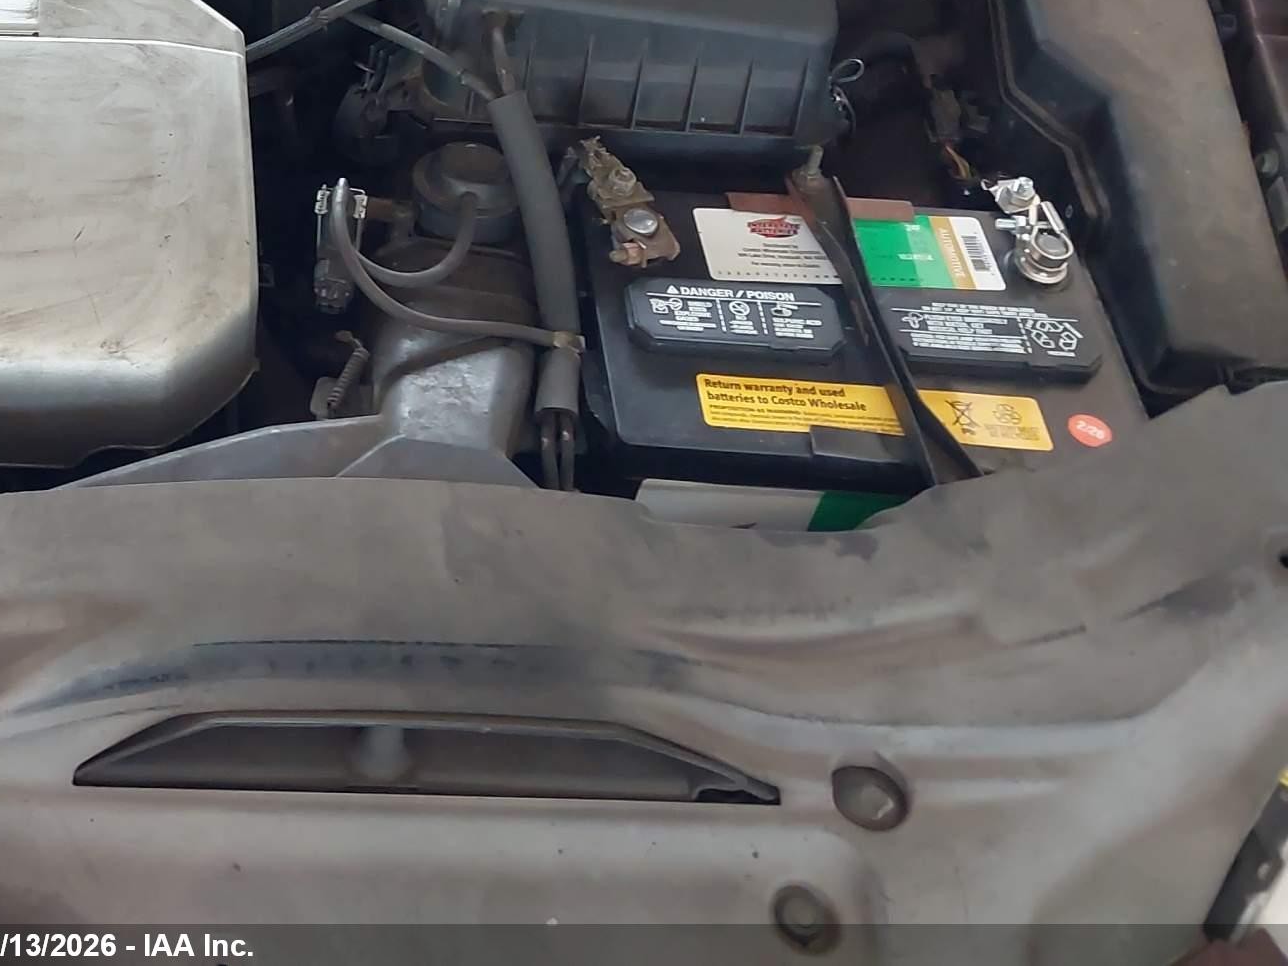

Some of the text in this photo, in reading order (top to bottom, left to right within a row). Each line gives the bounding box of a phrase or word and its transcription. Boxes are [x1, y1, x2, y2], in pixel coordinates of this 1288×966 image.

[680, 286, 734, 298] DANGER
[746, 290, 795, 301] POISON
[704, 378, 845, 398] Return warranty and used
[707, 390, 867, 411] batteries to Costco Wholesale
